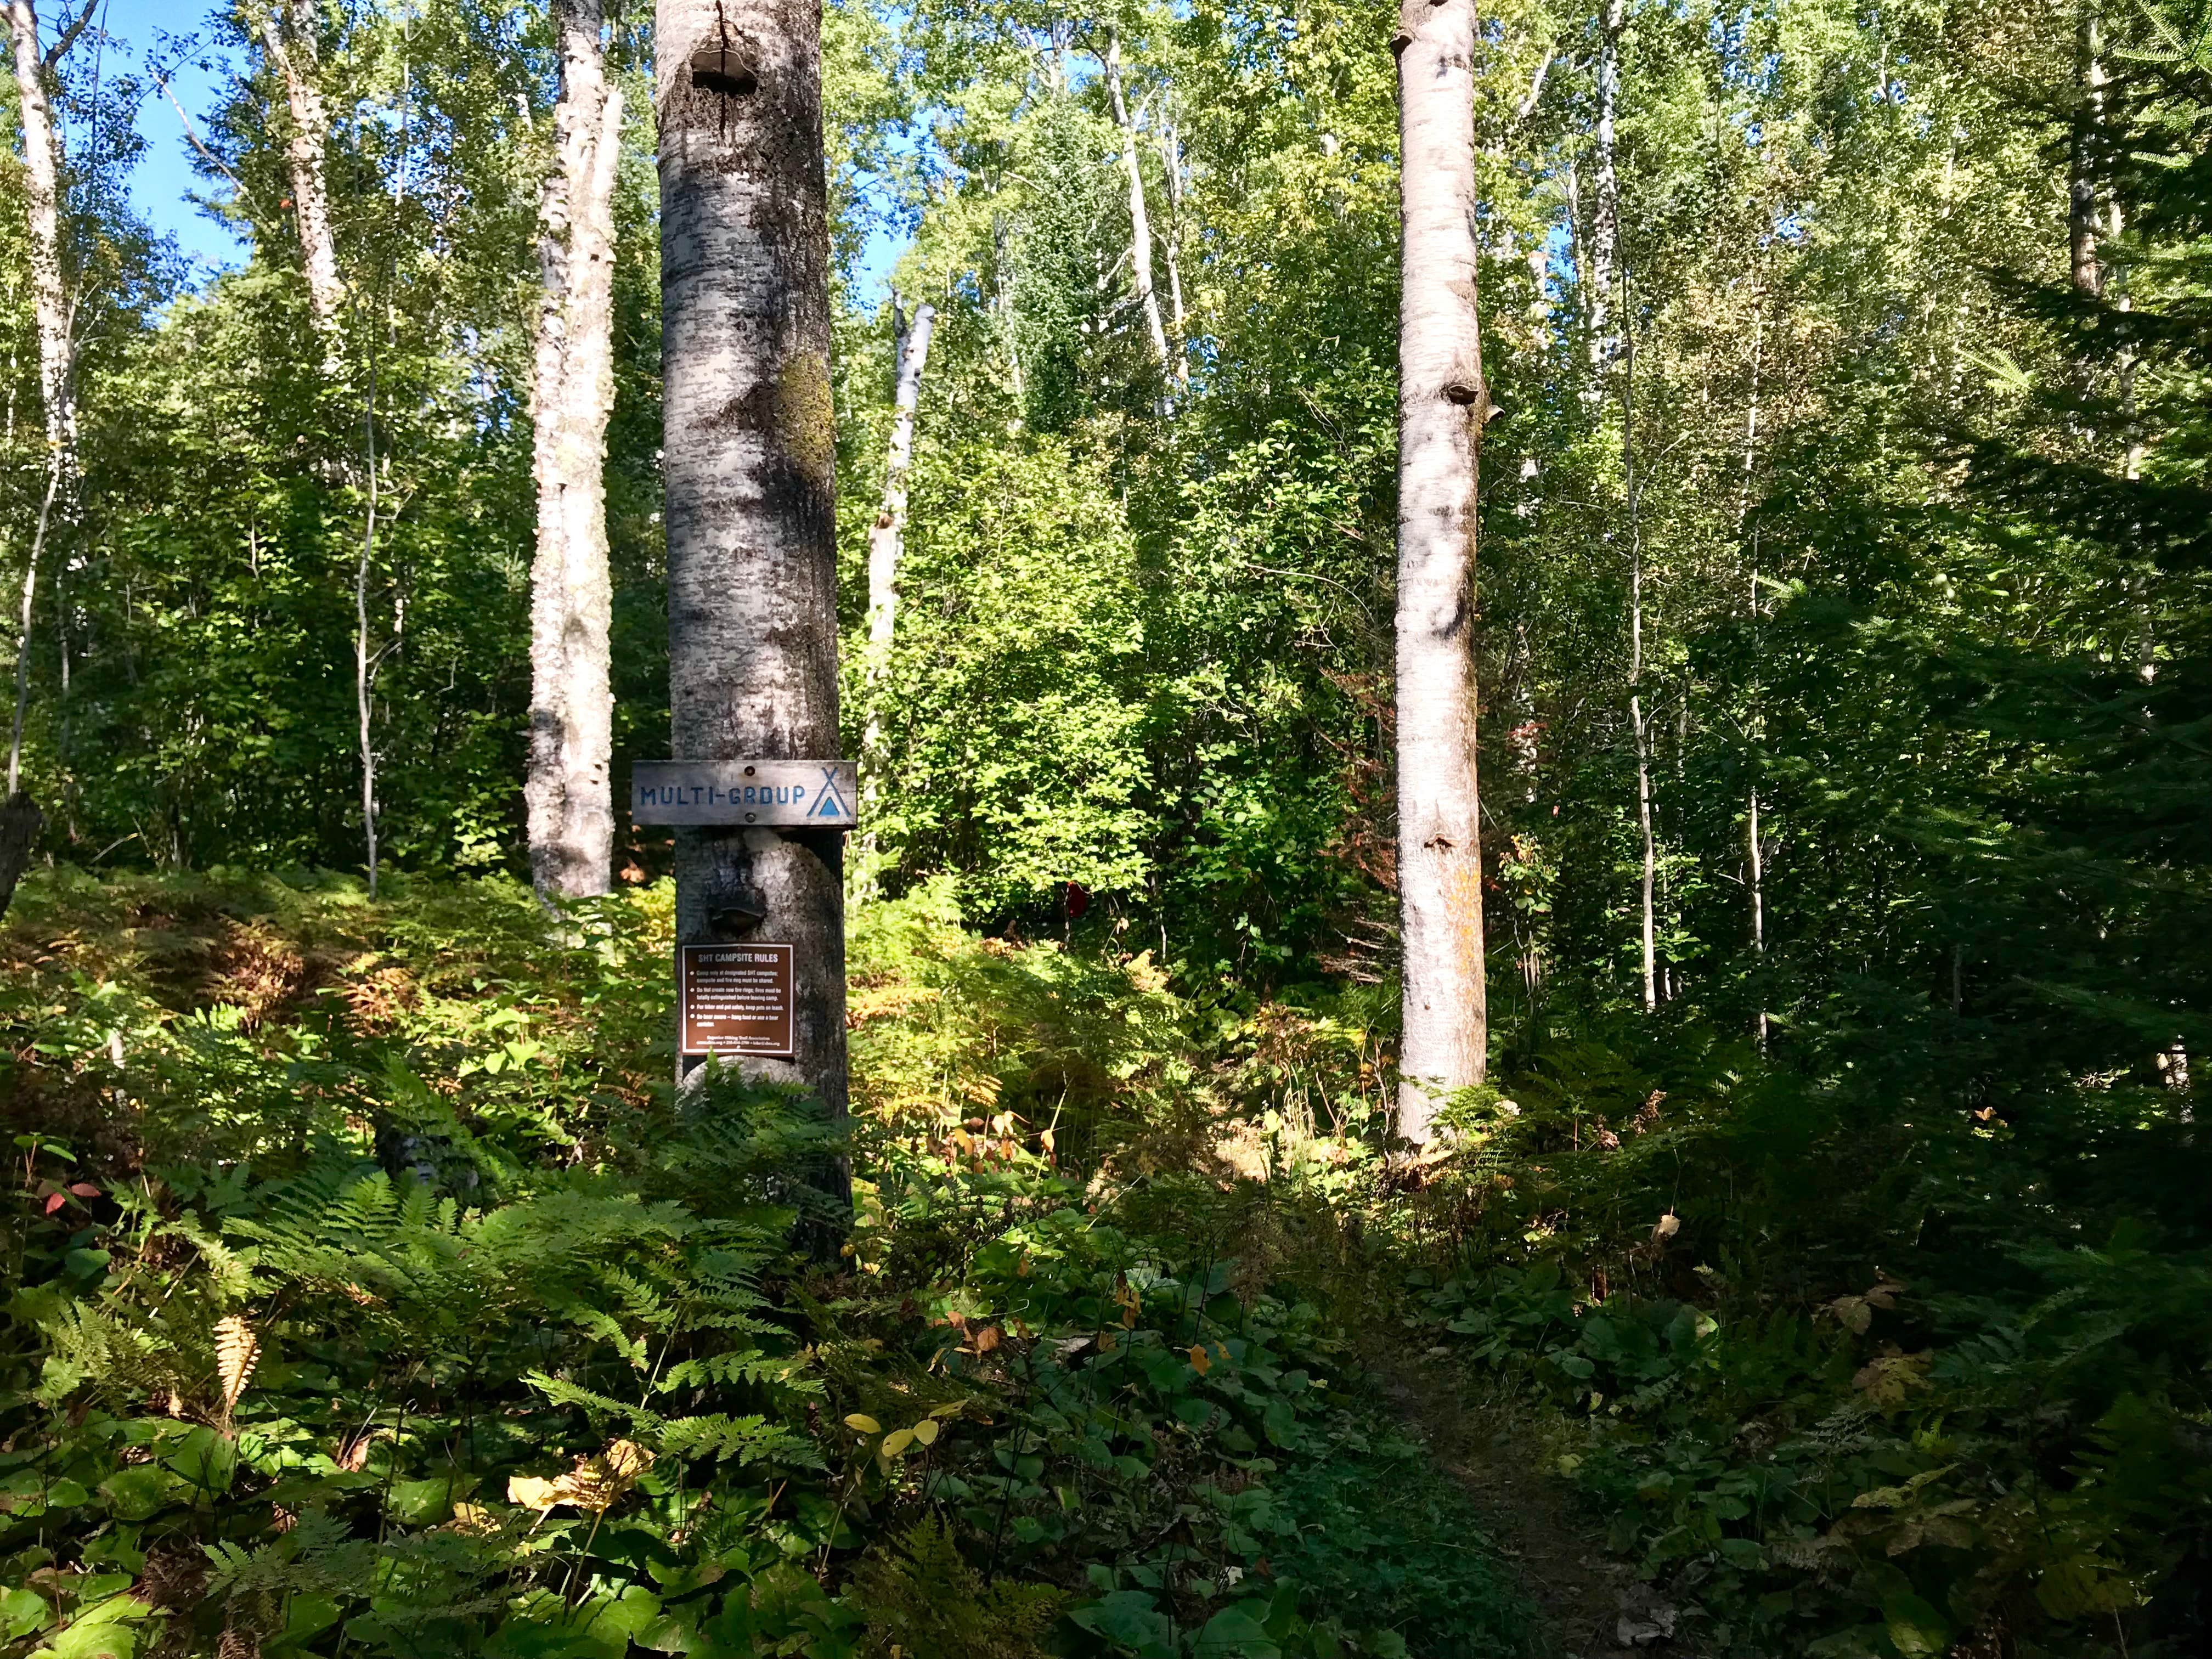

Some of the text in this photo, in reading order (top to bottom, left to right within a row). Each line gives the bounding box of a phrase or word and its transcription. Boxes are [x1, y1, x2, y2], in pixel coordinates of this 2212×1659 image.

[640, 785, 805, 806] MULTI-GROUP
[698, 954, 778, 962] SHT CAMPSITE RULES
